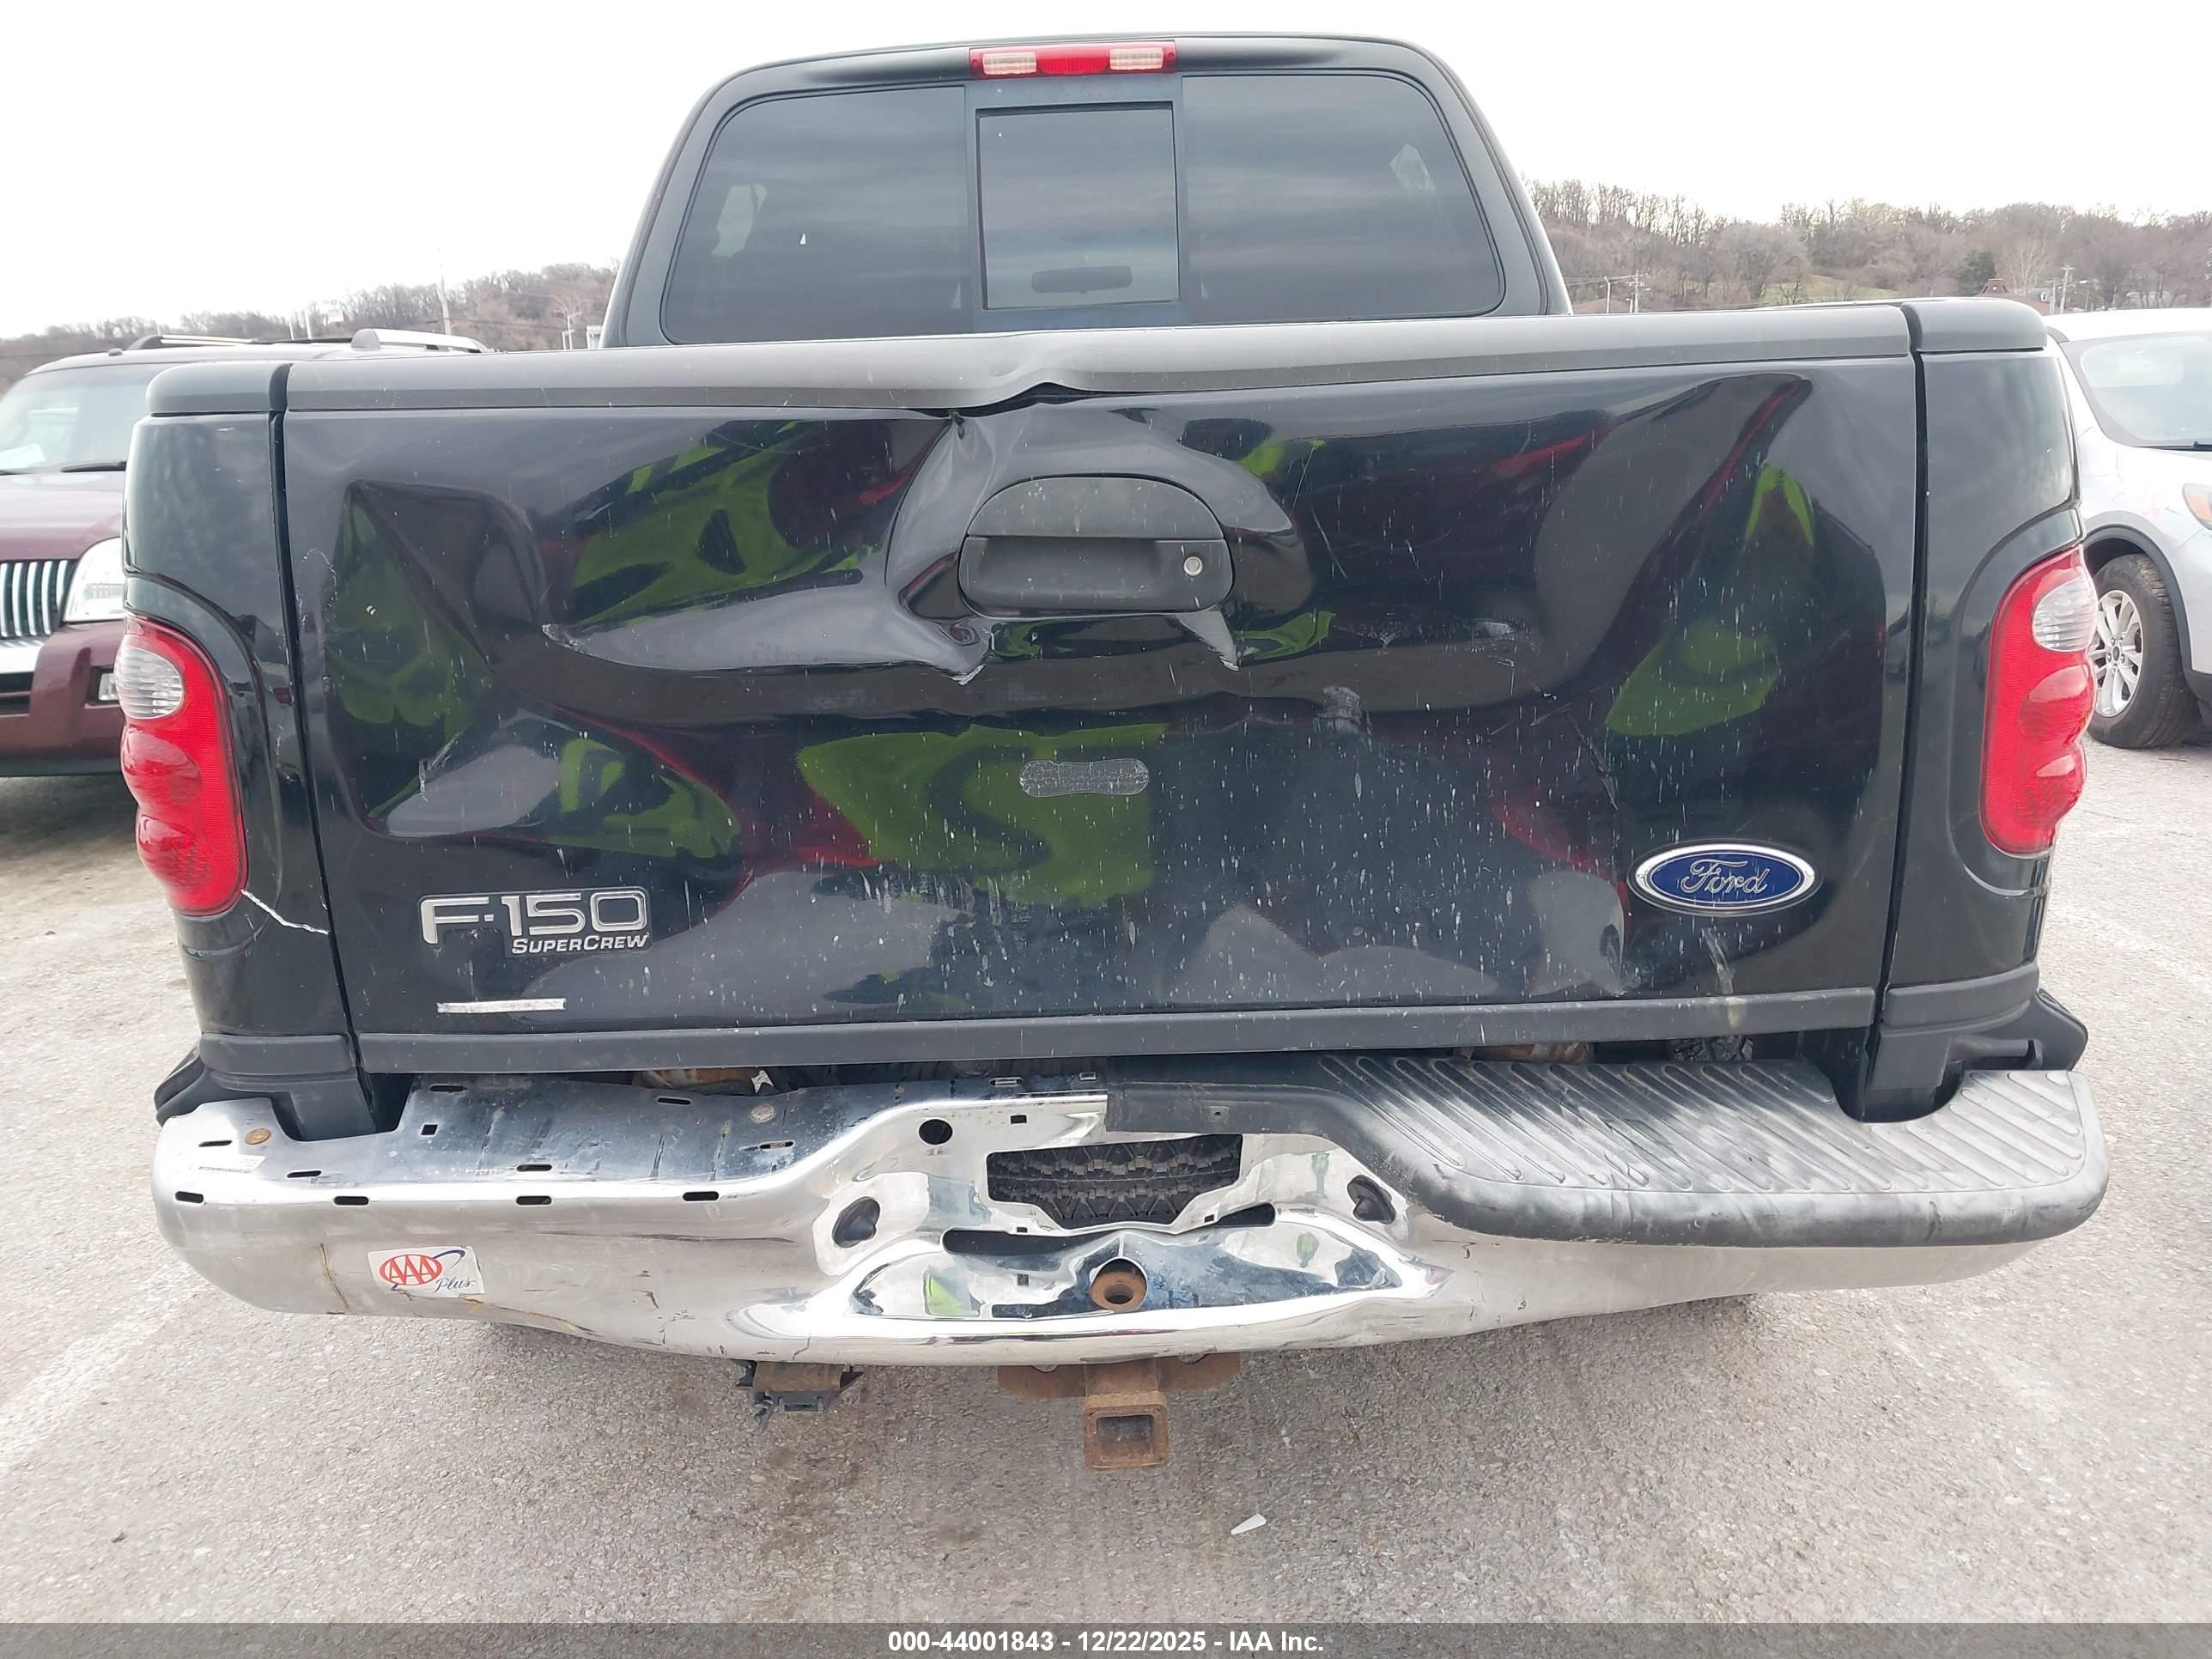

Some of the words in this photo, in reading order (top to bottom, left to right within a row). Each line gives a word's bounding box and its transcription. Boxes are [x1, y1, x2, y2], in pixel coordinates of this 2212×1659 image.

[1680, 859, 1771, 894] Ford
[420, 891, 647, 945] F-150
[386, 1254, 439, 1285] AAA
[433, 1276, 472, 1294] Plus
